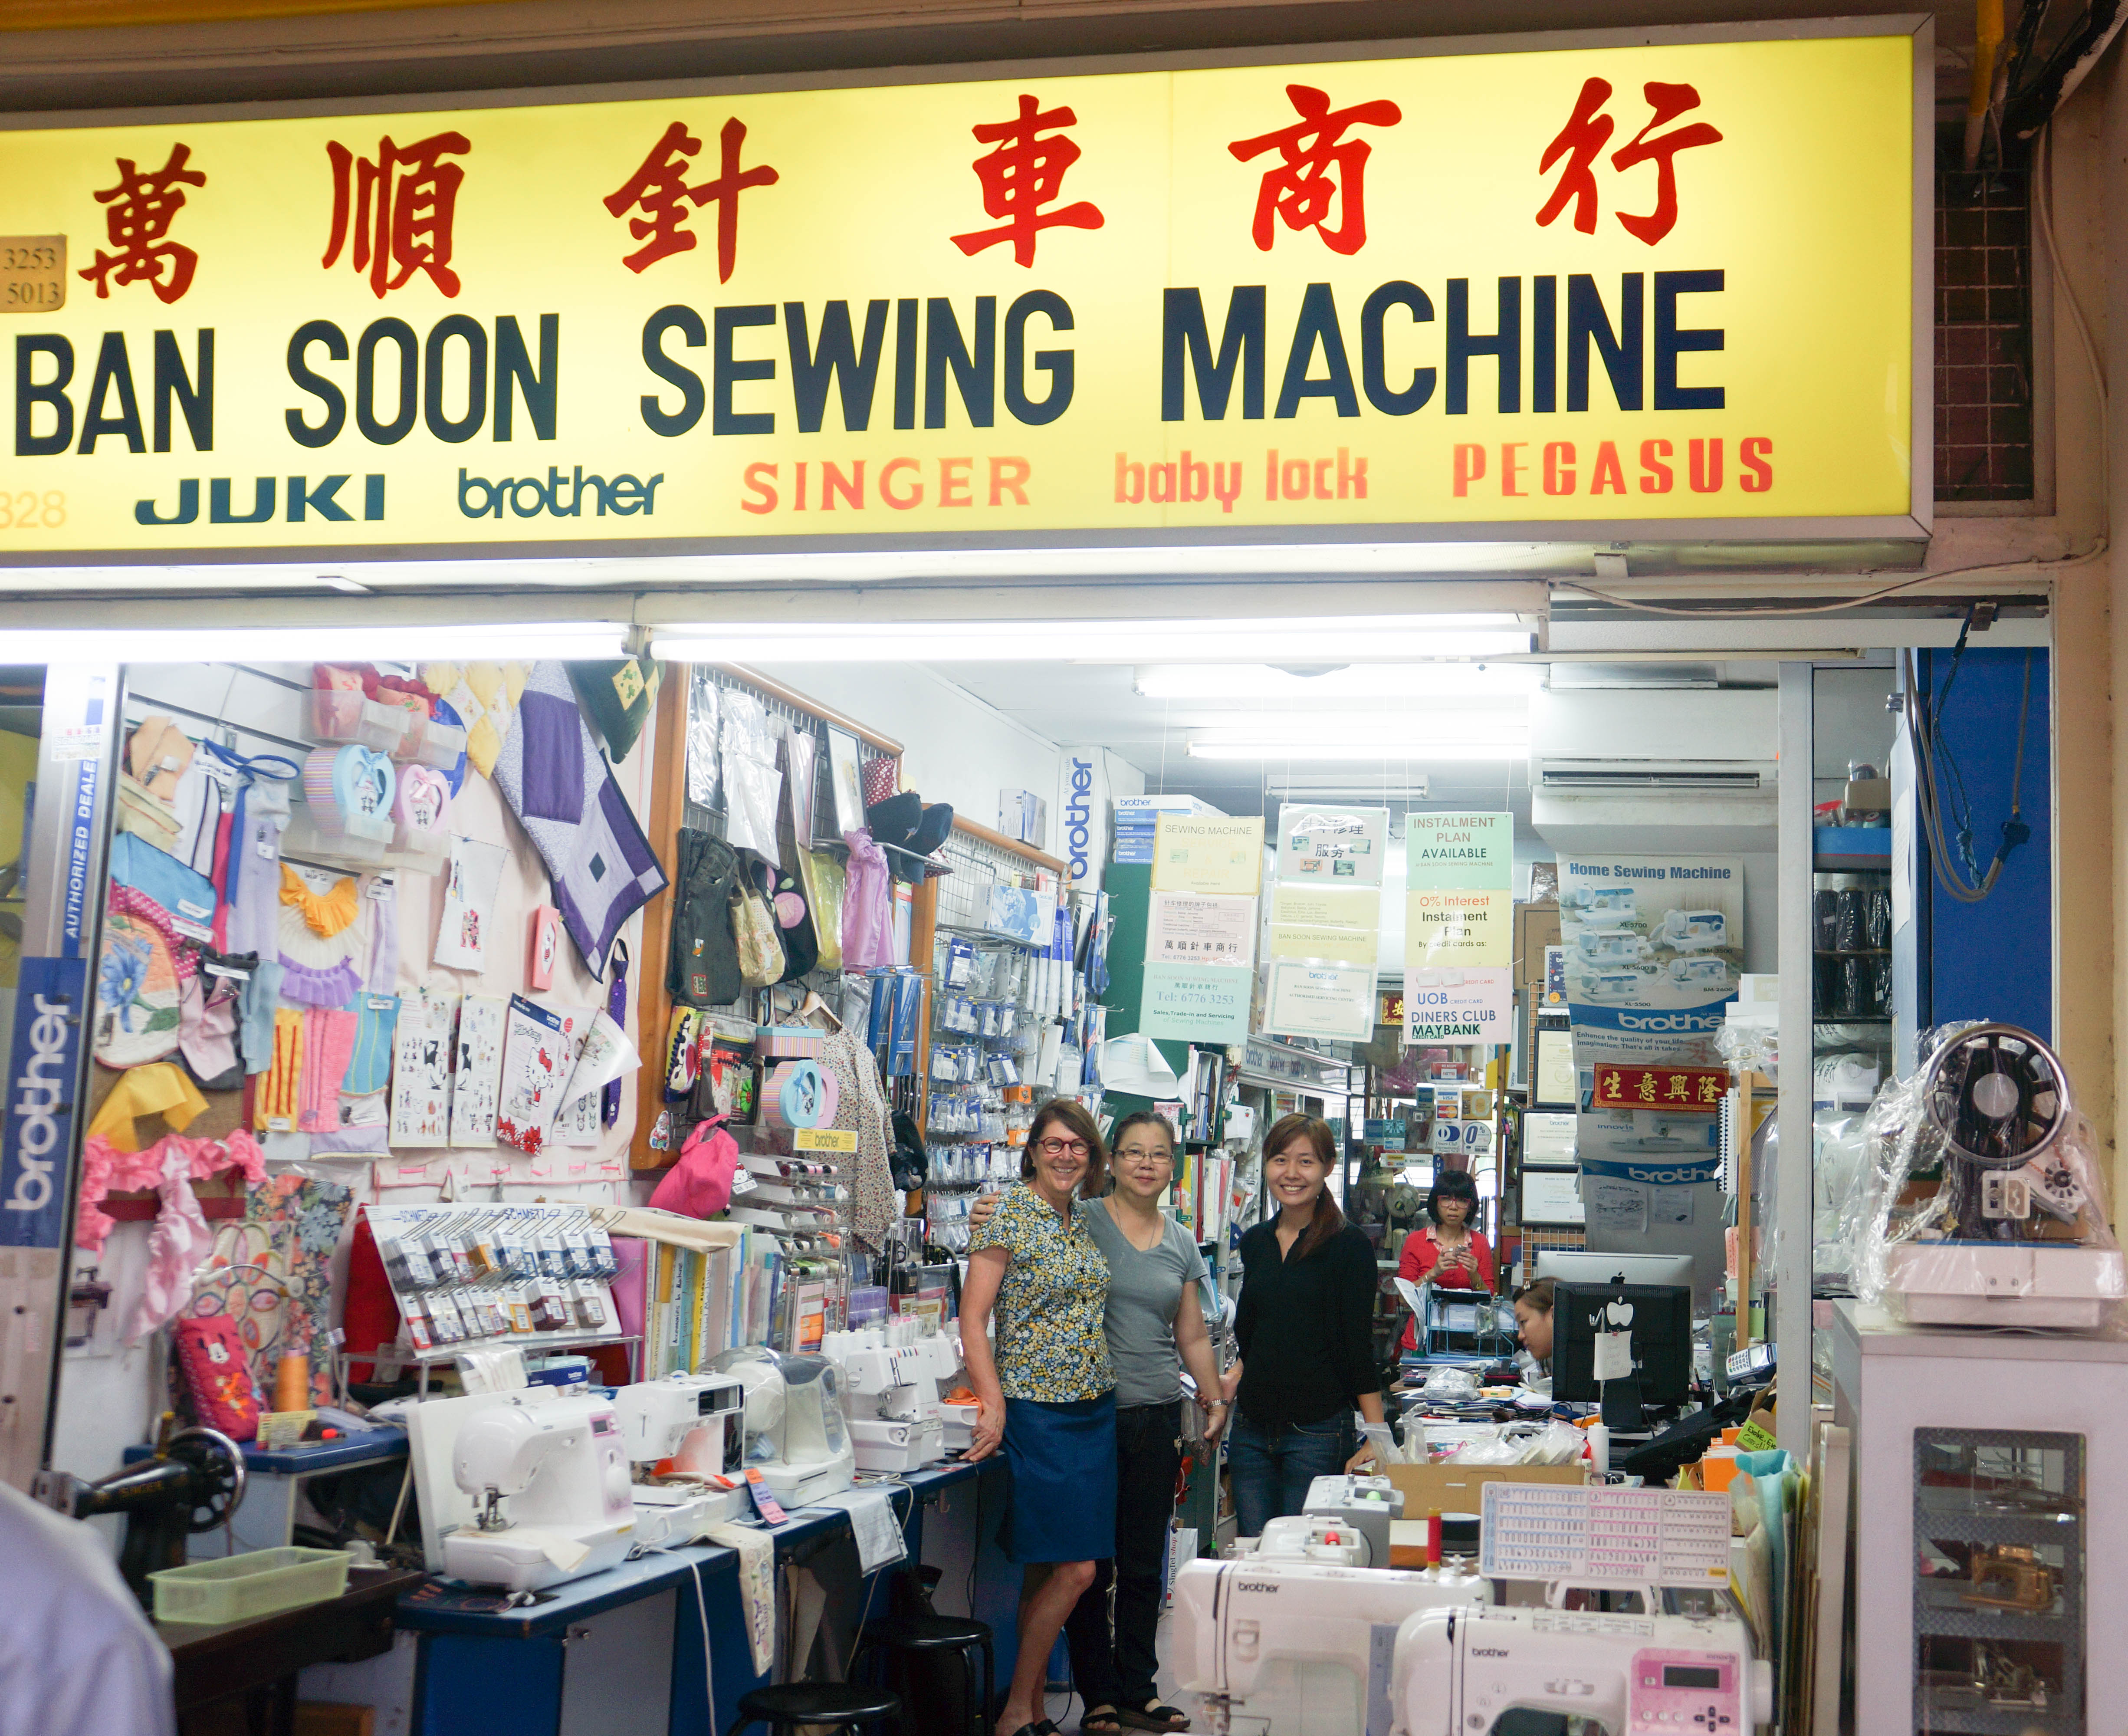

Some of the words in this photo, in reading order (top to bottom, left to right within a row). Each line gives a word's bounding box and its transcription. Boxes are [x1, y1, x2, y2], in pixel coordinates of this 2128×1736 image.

[79, 77, 1724, 304] 萬順針車商行
[3, 248, 56, 269] 3253
[7, 282, 59, 303] 5013
[15, 328, 215, 456] BAN
[285, 313, 559, 448] SOON
[640, 289, 1075, 437] SEWING
[1161, 269, 1725, 421] MACHINE
[1452, 437, 1773, 498] PEGASUS
[741, 456, 1031, 515] SINGER
[1114, 450, 1243, 513] baby
[1265, 446, 1368, 501] lock
[135, 474, 386, 525] JUKI
[458, 466, 664, 519] brother
[1065, 757, 1092, 880] brother
[1414, 817, 1495, 829] INSTALMENT
[1165, 825, 1205, 834] SEWING
[1208, 826, 1252, 835] MACHINE
[1437, 832, 1471, 842] PLAN
[1422, 848, 1486, 858] AVAILABLE
[1570, 862, 1609, 876] Home
[1614, 865, 1665, 879] Sewing
[1670, 866, 1731, 879] Machine
[65, 825, 89, 938] AUTHORIZED
[1445, 895, 1490, 906] Interest
[1165, 940, 1238, 953] 萬順針車商行
[1309, 971, 1338, 980] brother
[1156, 990, 1177, 1002] Tel:
[1181, 993, 1206, 1003] 6776
[1209, 995, 1234, 1005] 3253
[1418, 993, 1448, 1005] UOB
[1412, 1011, 1458, 1023] DINERS
[1462, 1010, 1496, 1022] CLUB
[1618, 1012, 1726, 1031] brothe
[1412, 1024, 1481, 1036] MAYBANK
[1577, 1031, 1605, 1040] Enhance
[1620, 1036, 1644, 1044] quality
[1577, 1040, 1619, 1049] Imagination:
[1603, 1071, 1723, 1103] 生意興隆
[6, 993, 72, 1212] brother
[815, 1132, 839, 1148] brother
[400, 1209, 428, 1223] SCHMET
[1239, 1581, 1280, 1593] brother
[1472, 1648, 1510, 1657] brother
